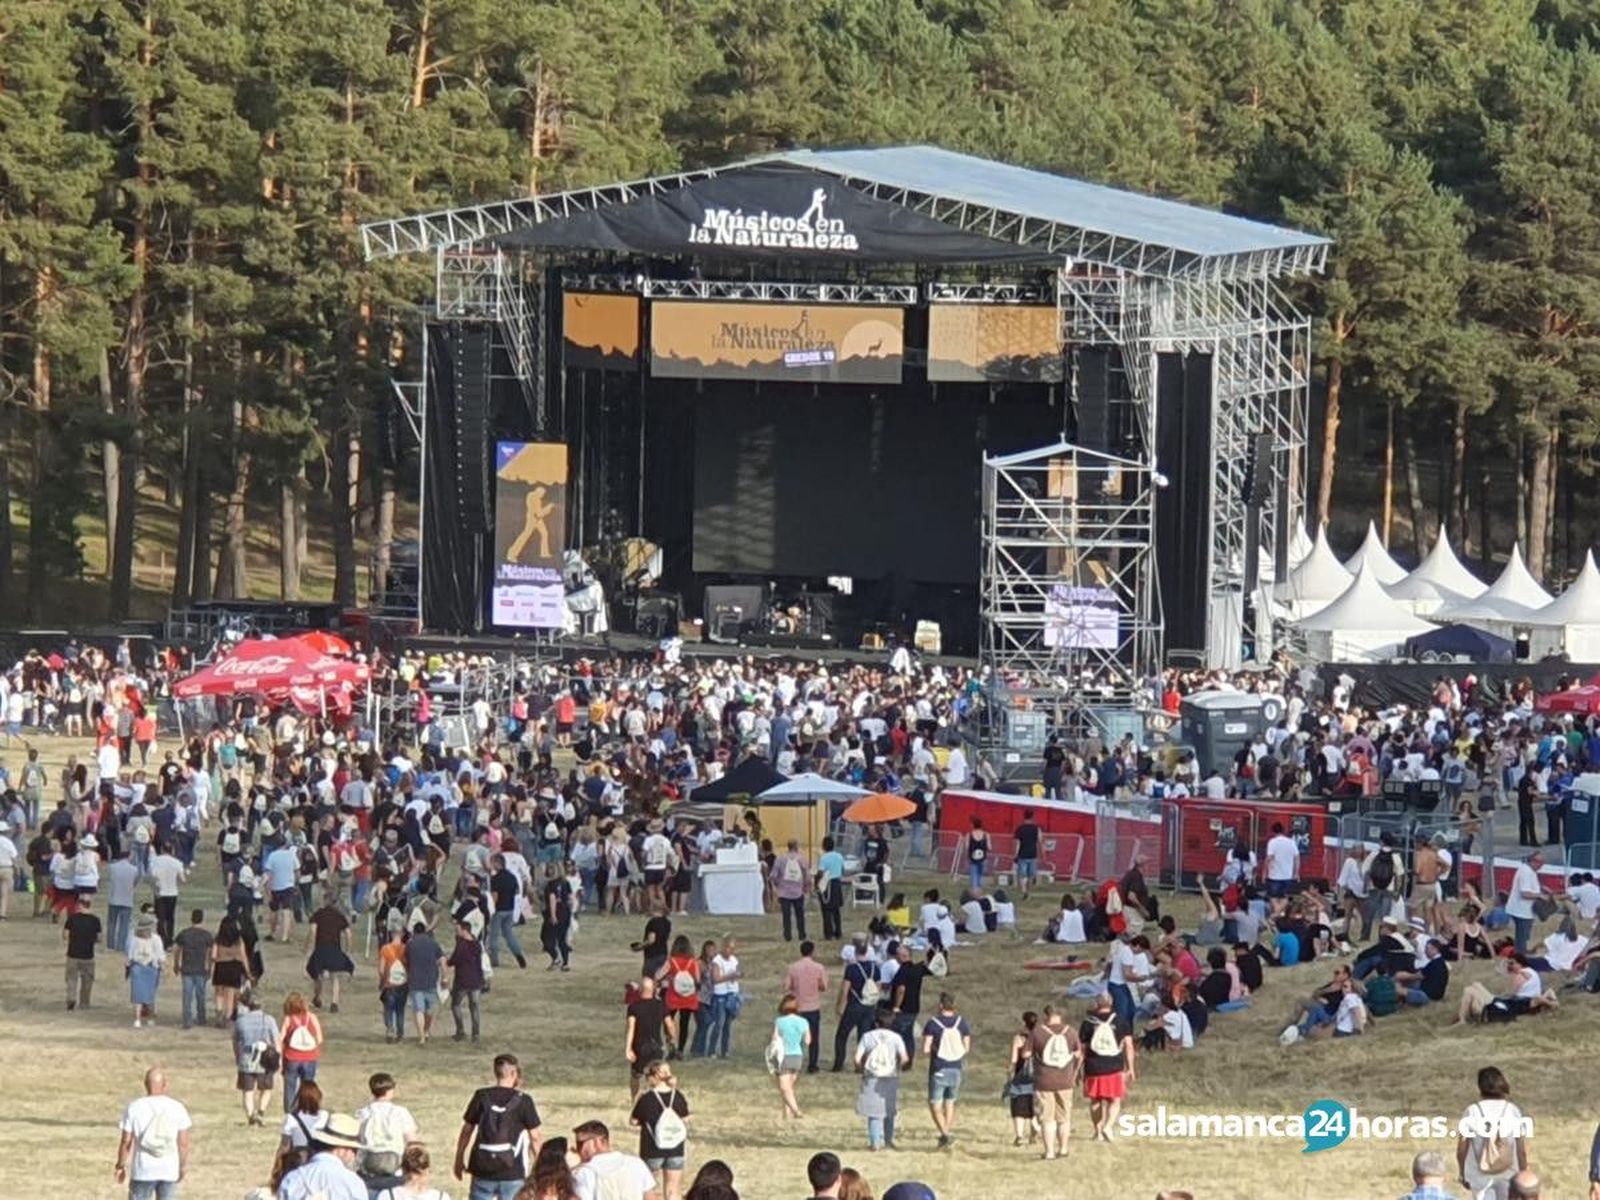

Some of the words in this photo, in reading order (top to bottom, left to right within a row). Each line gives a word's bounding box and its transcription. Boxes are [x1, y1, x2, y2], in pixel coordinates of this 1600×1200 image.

[703, 208, 813, 233] Músicos
[815, 217, 845, 234] en
[688, 223, 711, 243] la
[714, 225, 858, 250] Naturaleza
[721, 321, 802, 339] Músicos
[730, 334, 835, 351] Naturaleza
